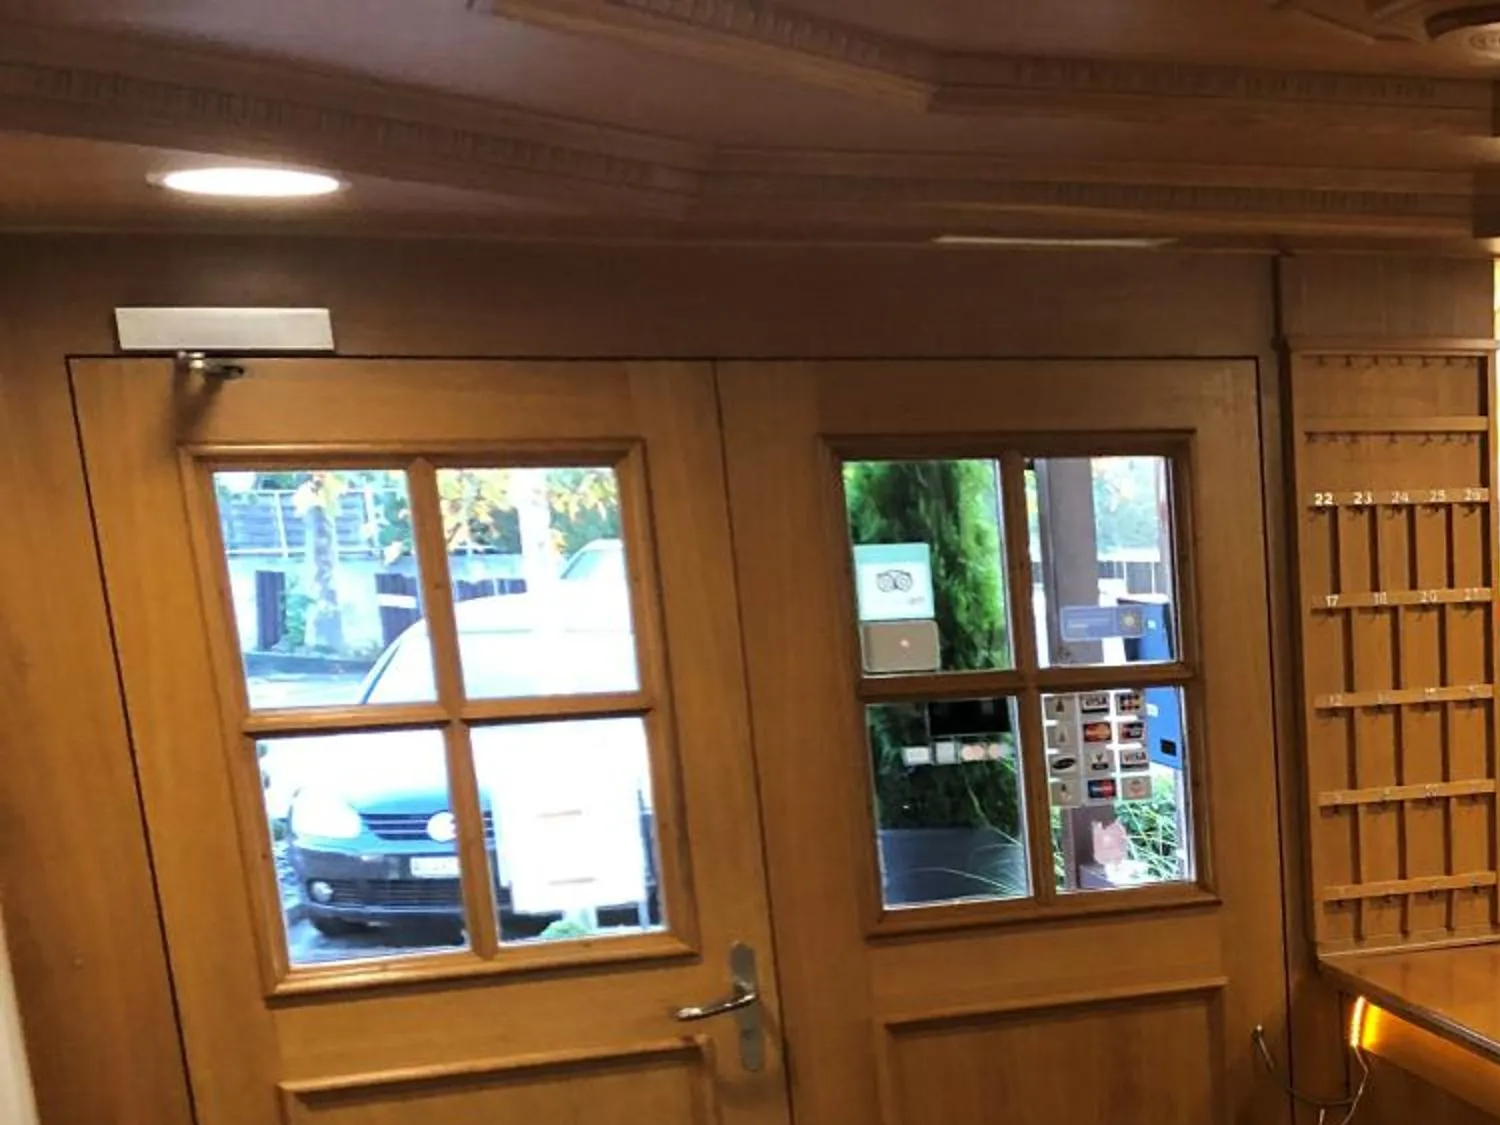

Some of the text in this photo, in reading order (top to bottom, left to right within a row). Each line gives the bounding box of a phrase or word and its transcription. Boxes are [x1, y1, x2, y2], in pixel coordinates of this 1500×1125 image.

[1314, 493, 1334, 506] 22
[1352, 491, 1373, 505] 23
[1430, 489, 1446, 502] 25
[1326, 594, 1339, 607] 17
